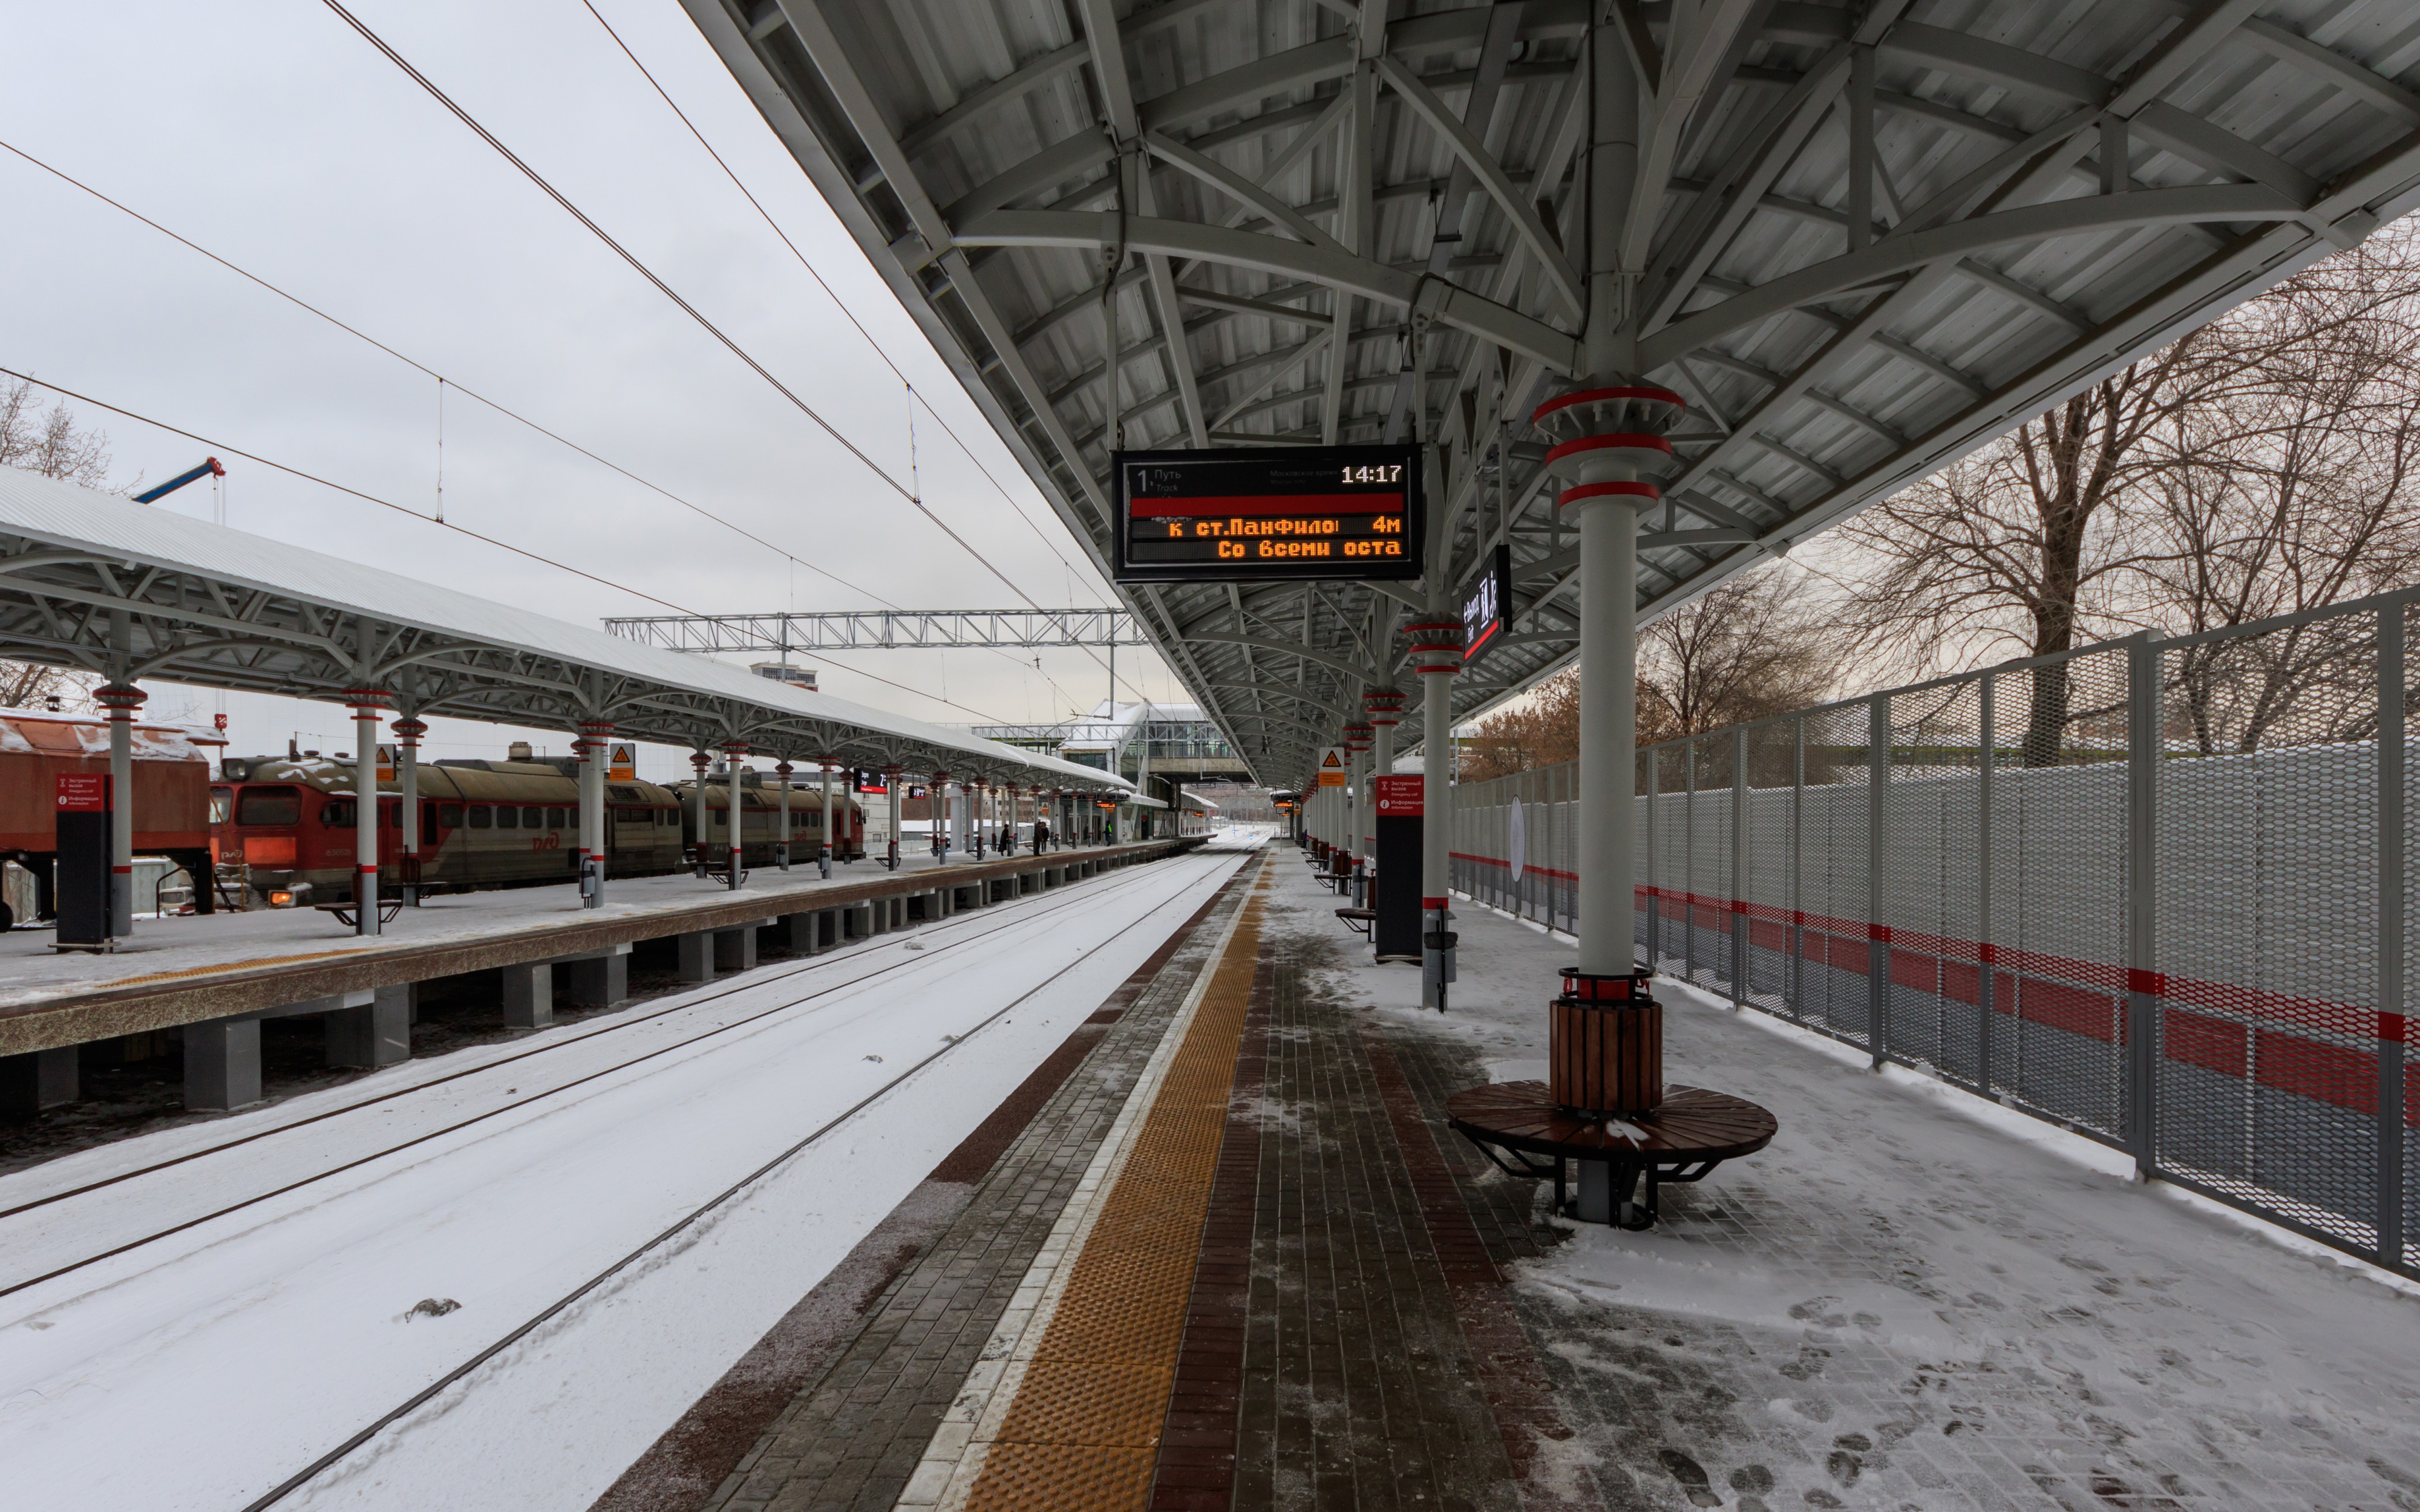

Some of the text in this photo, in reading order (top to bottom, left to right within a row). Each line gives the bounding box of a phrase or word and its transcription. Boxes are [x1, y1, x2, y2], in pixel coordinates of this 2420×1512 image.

[1154, 469, 1182, 481] Путь
[1342, 465, 1401, 483] 14:17
[1197, 518, 1339, 536] ст.Панфило
[1218, 540, 1402, 558] Со всеми оста
